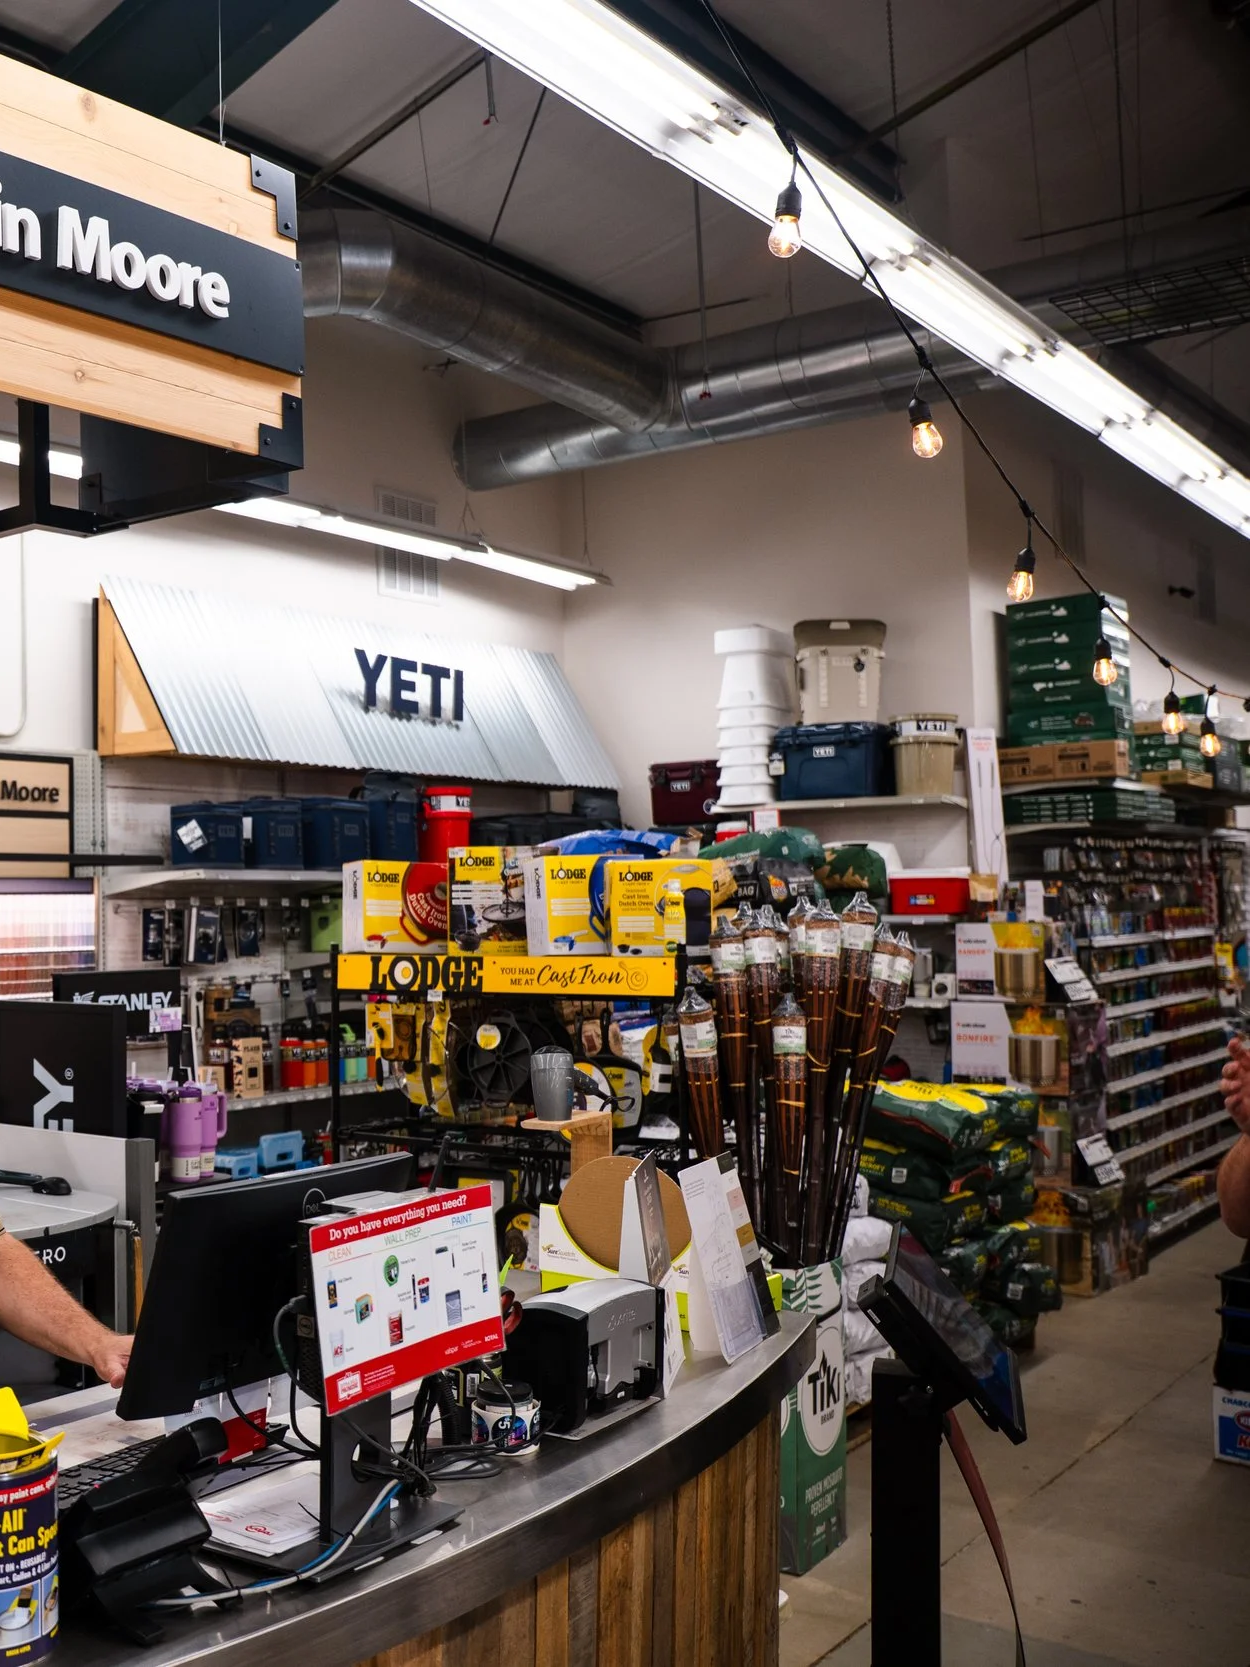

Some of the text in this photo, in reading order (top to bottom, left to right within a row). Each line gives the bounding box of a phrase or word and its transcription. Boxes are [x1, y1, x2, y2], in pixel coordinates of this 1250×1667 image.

[56, 205, 230, 319] Moore
[354, 648, 464, 722] YETI
[917, 719, 946, 732] YETI
[814, 746, 835, 757] YETI
[0, 780, 59, 803] Moore
[671, 781, 690, 792] YETI
[460, 856, 495, 867] LODGE
[367, 871, 400, 883] LODGE
[550, 869, 587, 880] LODGE
[619, 871, 653, 882] LODGE
[409, 893, 448, 929] Dutch Oven
[417, 892, 447, 921] Cast Iron
[369, 955, 484, 993] LODGE
[500, 963, 624, 989] YOU HAD Cast Iron
[510, 978, 535, 986] ME AT
[956, 1034, 995, 1043] BONFIRE
[329, 1194, 467, 1241] Do you have everything you need?
[452, 1213, 472, 1227] PAINT
[384, 1227, 422, 1246] WALL PREP
[328, 1246, 352, 1261] CLEAN
[821, 1409, 835, 1426] BRAND
[805, 1466, 843, 1504] PROVEN MOSQUITO
[10, 1488, 29, 1503] paint
[8, 1535, 35, 1555] Can
[5, 1562, 15, 1573] ON
[12, 1570, 32, 1582] Gallon
